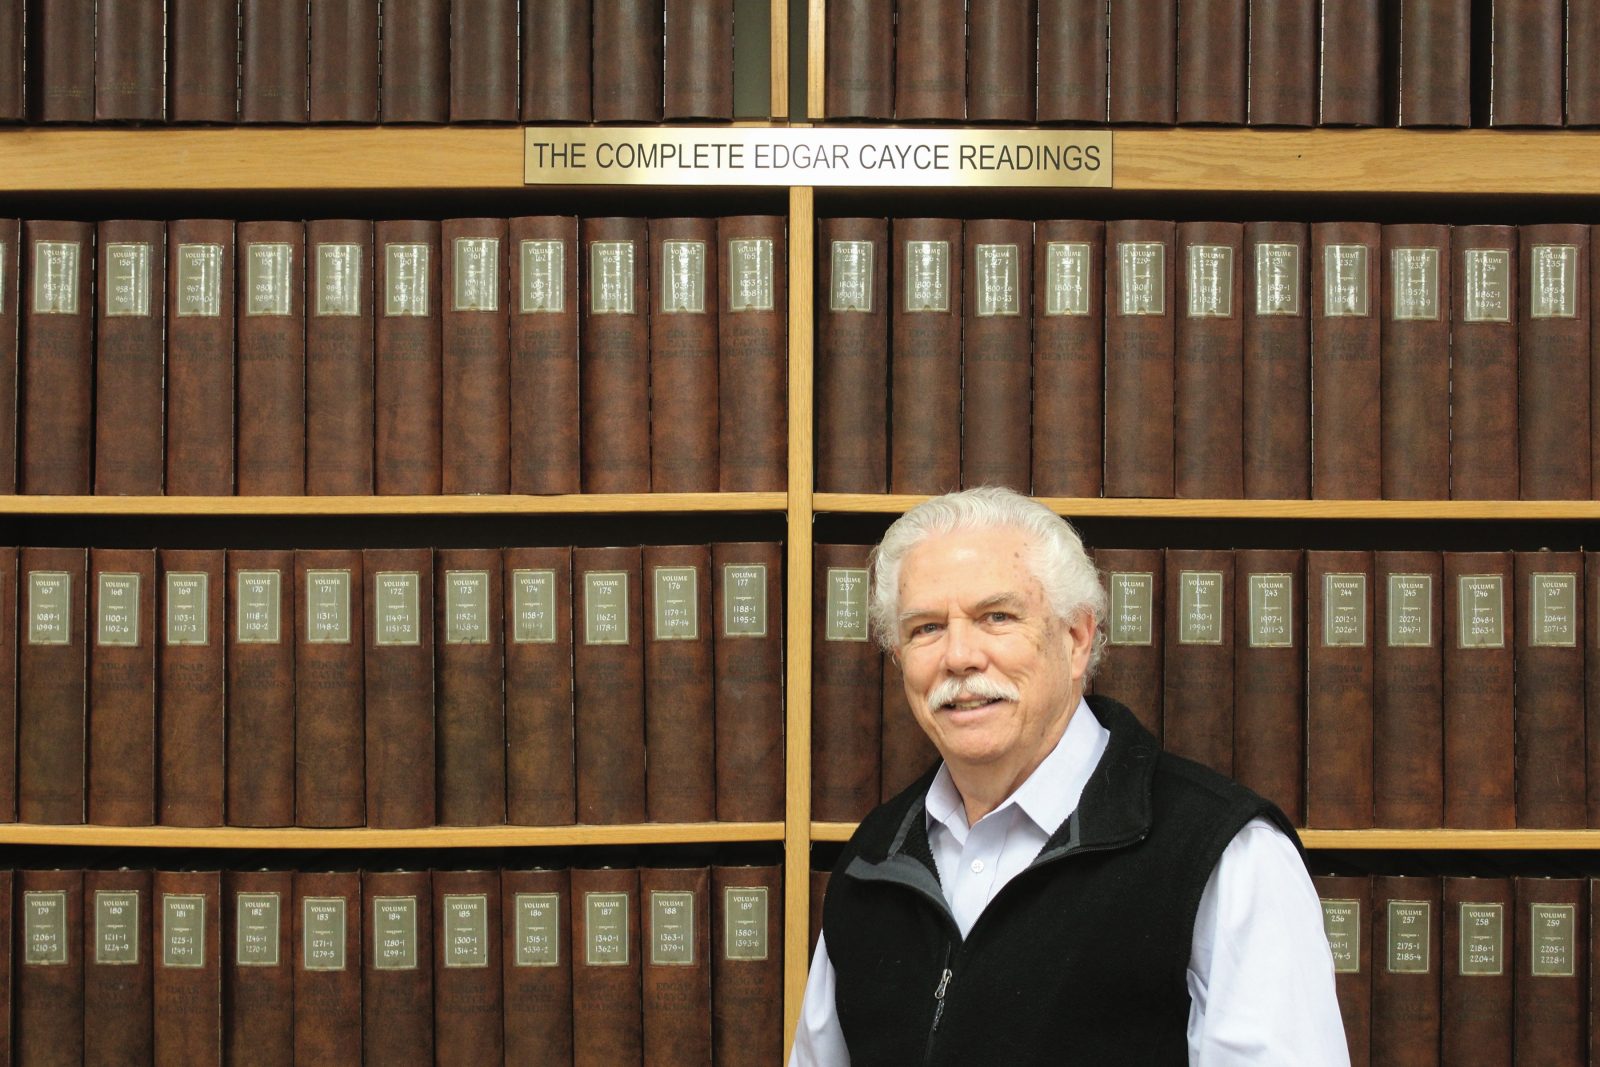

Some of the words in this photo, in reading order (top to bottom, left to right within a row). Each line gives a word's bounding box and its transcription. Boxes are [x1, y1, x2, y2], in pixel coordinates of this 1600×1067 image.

[533, 143, 586, 168] THE
[596, 143, 744, 168] COMPLETE
[755, 144, 849, 168] EDGAR
[859, 144, 949, 170] CAYCE
[959, 145, 1100, 170] READINGS
